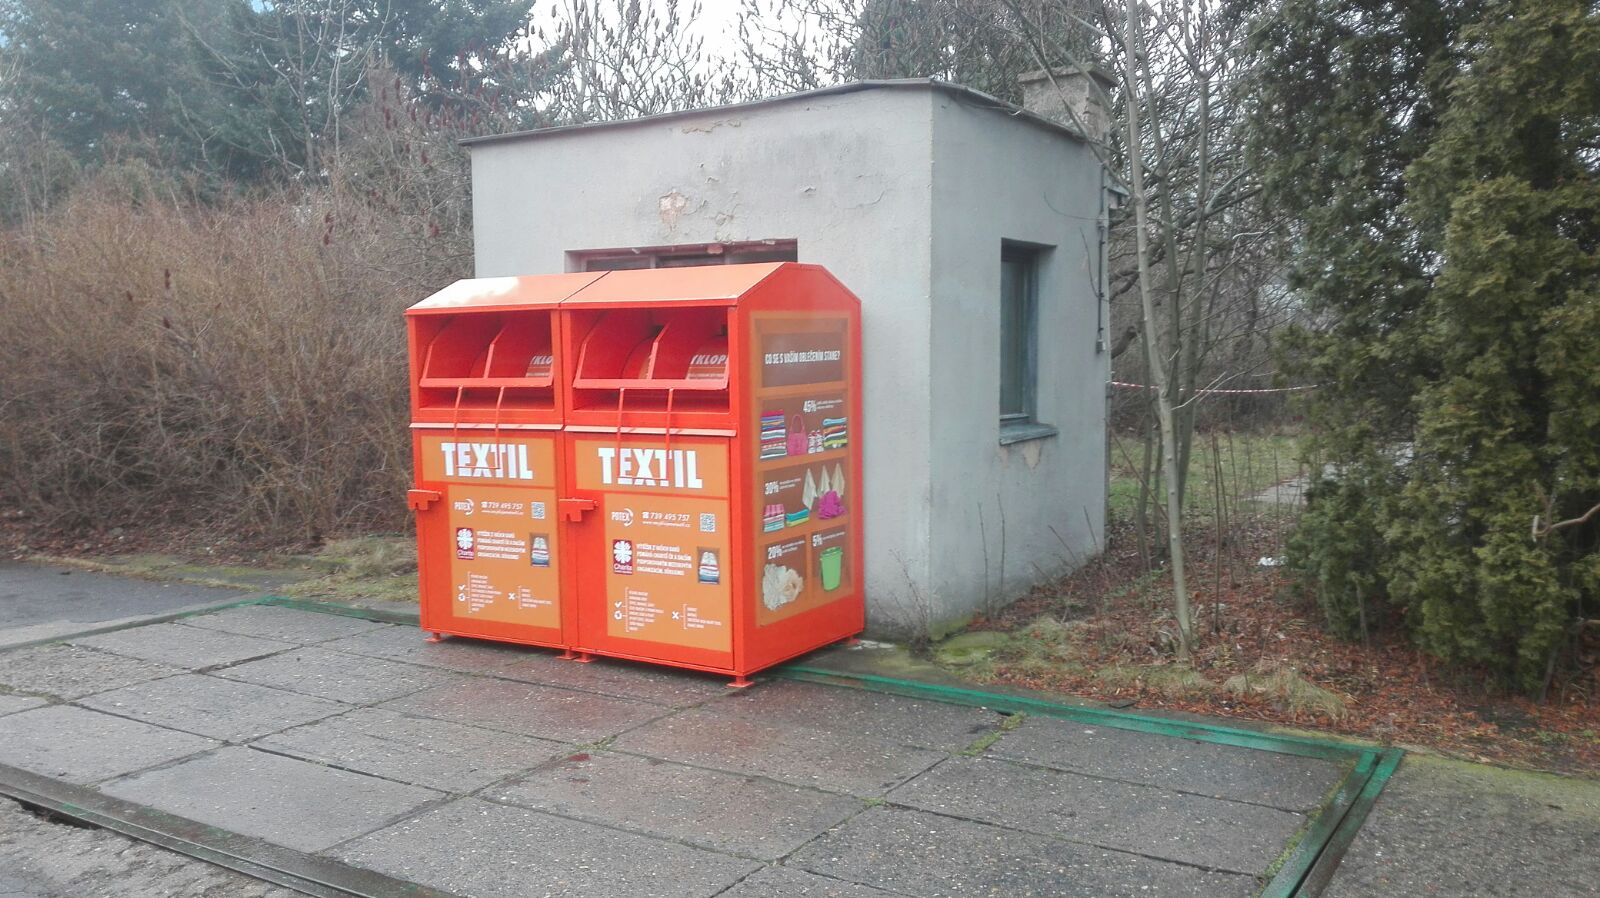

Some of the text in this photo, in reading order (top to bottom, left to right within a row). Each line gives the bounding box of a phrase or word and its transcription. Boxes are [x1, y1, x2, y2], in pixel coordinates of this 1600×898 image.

[765, 353, 772, 365] CO
[772, 353, 779, 364] SE
[779, 352, 784, 364] S
[824, 350, 841, 361] STANE?
[803, 399, 817, 413] 45%
[440, 442, 533, 480] TEXTIL
[597, 447, 703, 489] TEXTIL
[764, 481, 779, 495] 30%
[651, 512, 662, 520] 739
[678, 514, 690, 522] 757
[812, 533, 823, 547] 5%
[768, 544, 782, 559] 20%
